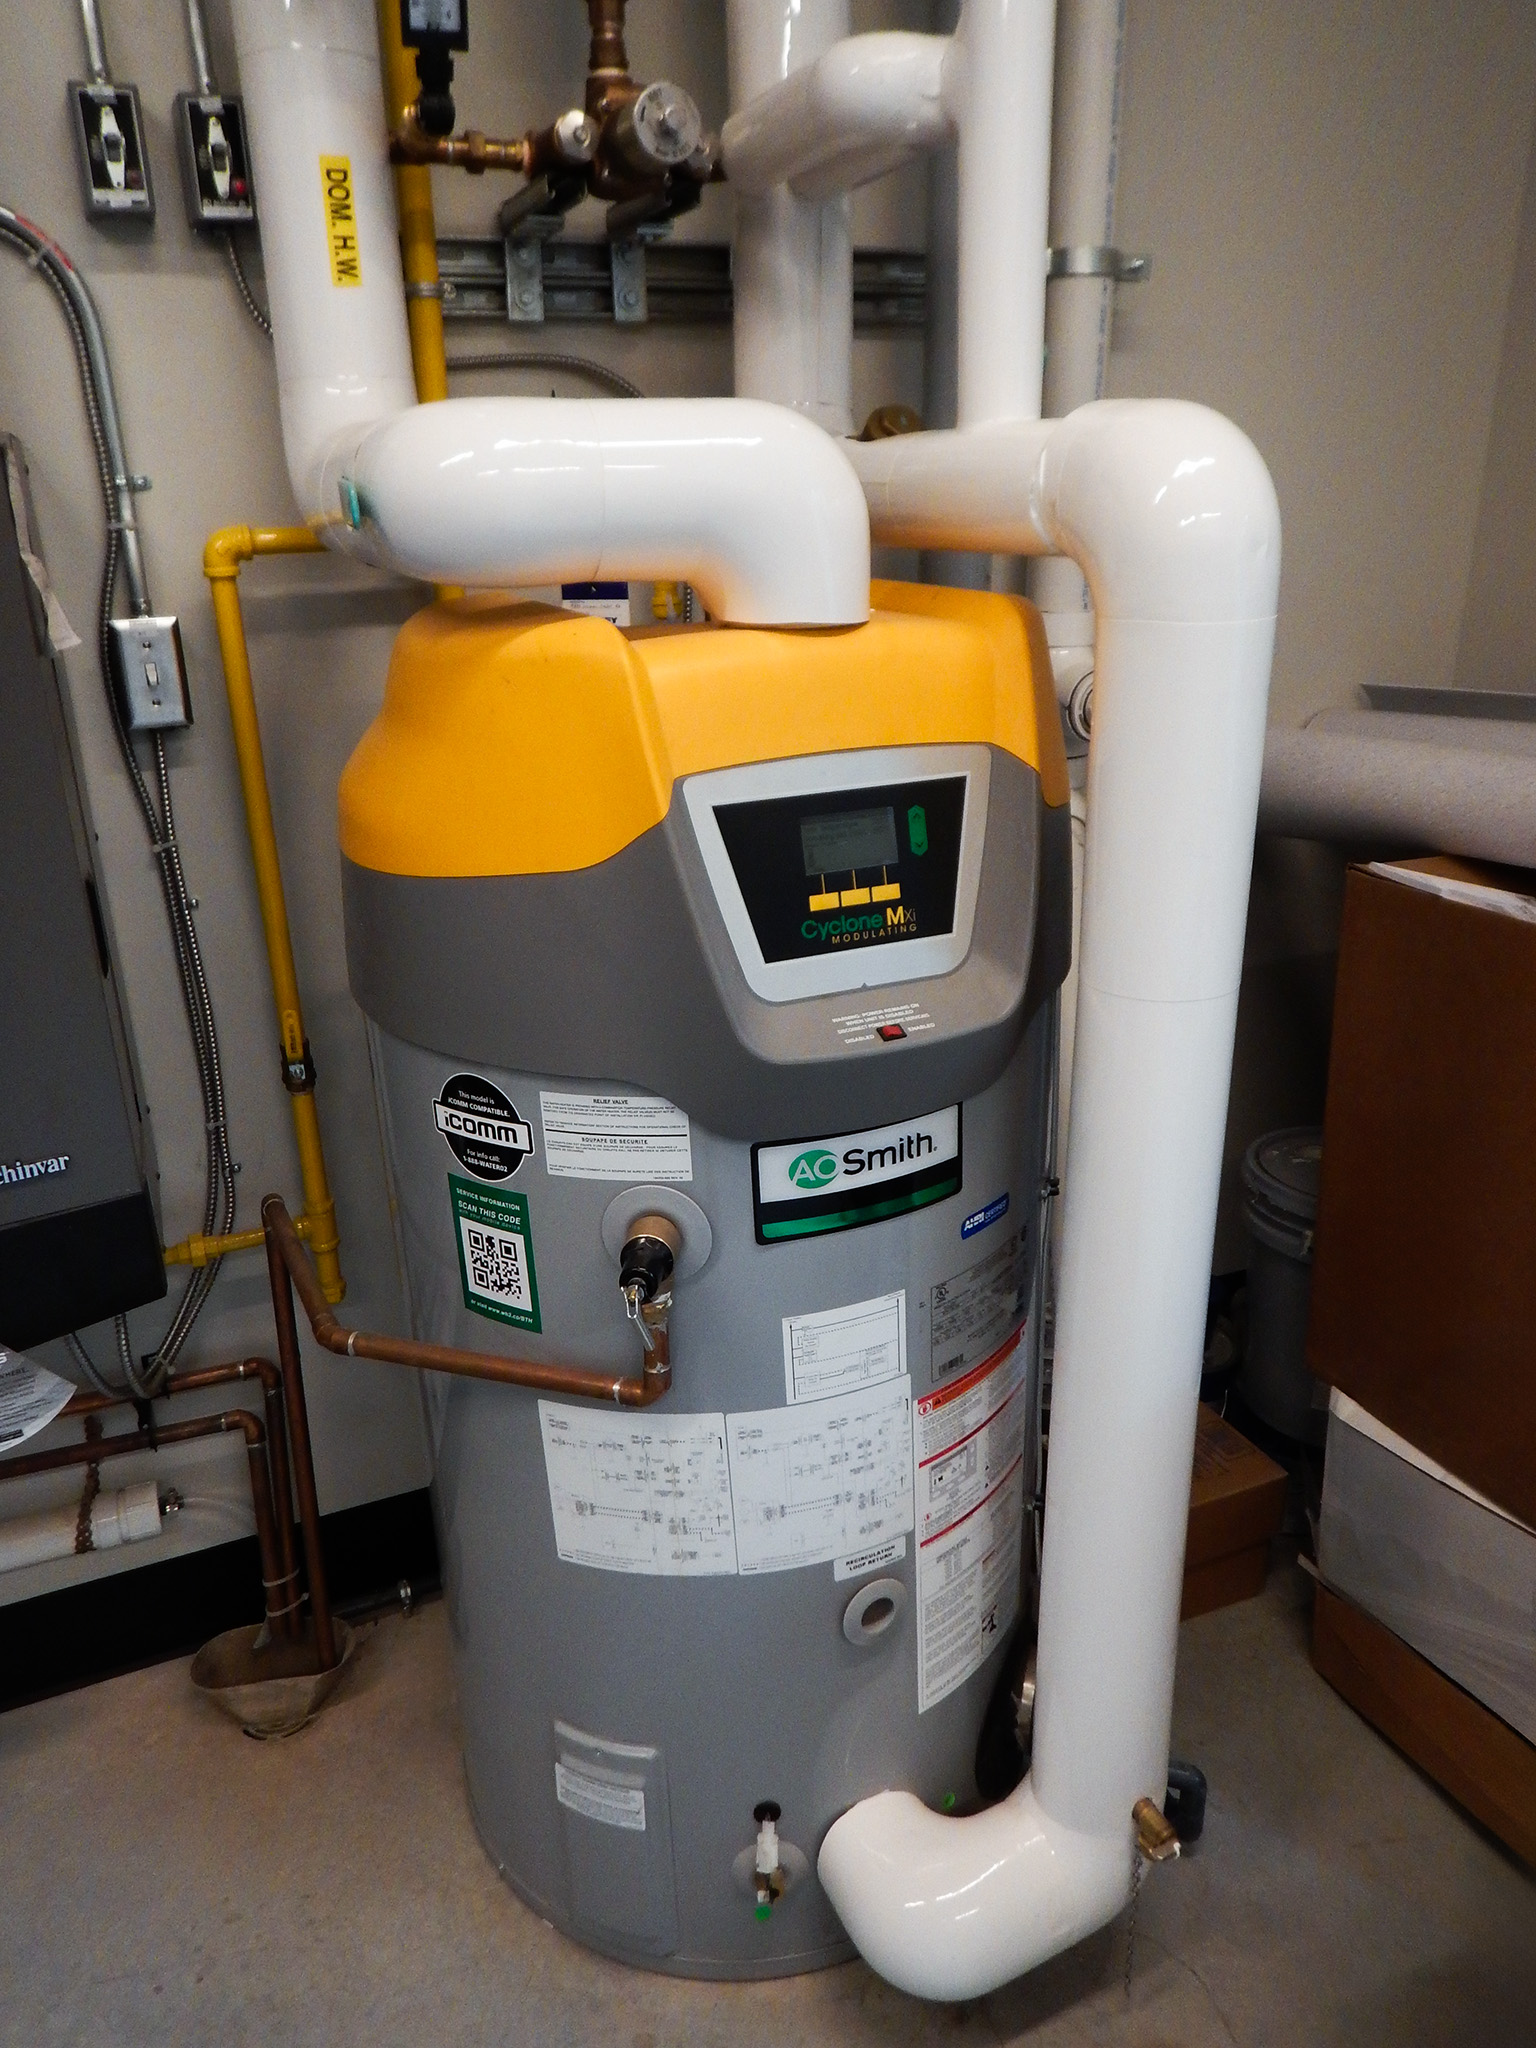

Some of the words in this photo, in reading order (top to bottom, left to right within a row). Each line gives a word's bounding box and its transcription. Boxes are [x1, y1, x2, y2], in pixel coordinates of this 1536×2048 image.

[326, 168, 353, 228] DOM.
[333, 235, 359, 281] H.W.
[801, 914, 883, 941] Cyclone
[886, 906, 917, 926] MXi
[832, 923, 918, 945] MODULATING
[862, 1009, 884, 1018] POWER
[884, 1004, 910, 1013] REMAINS
[885, 1009, 914, 1019] DISABLED
[837, 1024, 868, 1034] DISCONNECT
[886, 1017, 905, 1025] BEFORE
[844, 1034, 875, 1044] DISABLED
[908, 1022, 936, 1032] ENABLED
[459, 1090, 470, 1099] This
[471, 1094, 488, 1104] model
[469, 1102, 511, 1117] COMPATIBLE.
[467, 1149, 475, 1157] For
[477, 1151, 488, 1160] info
[842, 1132, 933, 1176] Smith
[456, 1187, 479, 1200] SERVICE
[479, 1196, 520, 1211] INFORMATION
[458, 1200, 477, 1213] SCAN
[479, 1207, 496, 1219] THIS
[498, 1213, 521, 1225] CODE
[846, 1545, 896, 1566] RECIRCULATION
[849, 1561, 866, 1571] LOOP
[867, 1552, 893, 1566] RETURN
